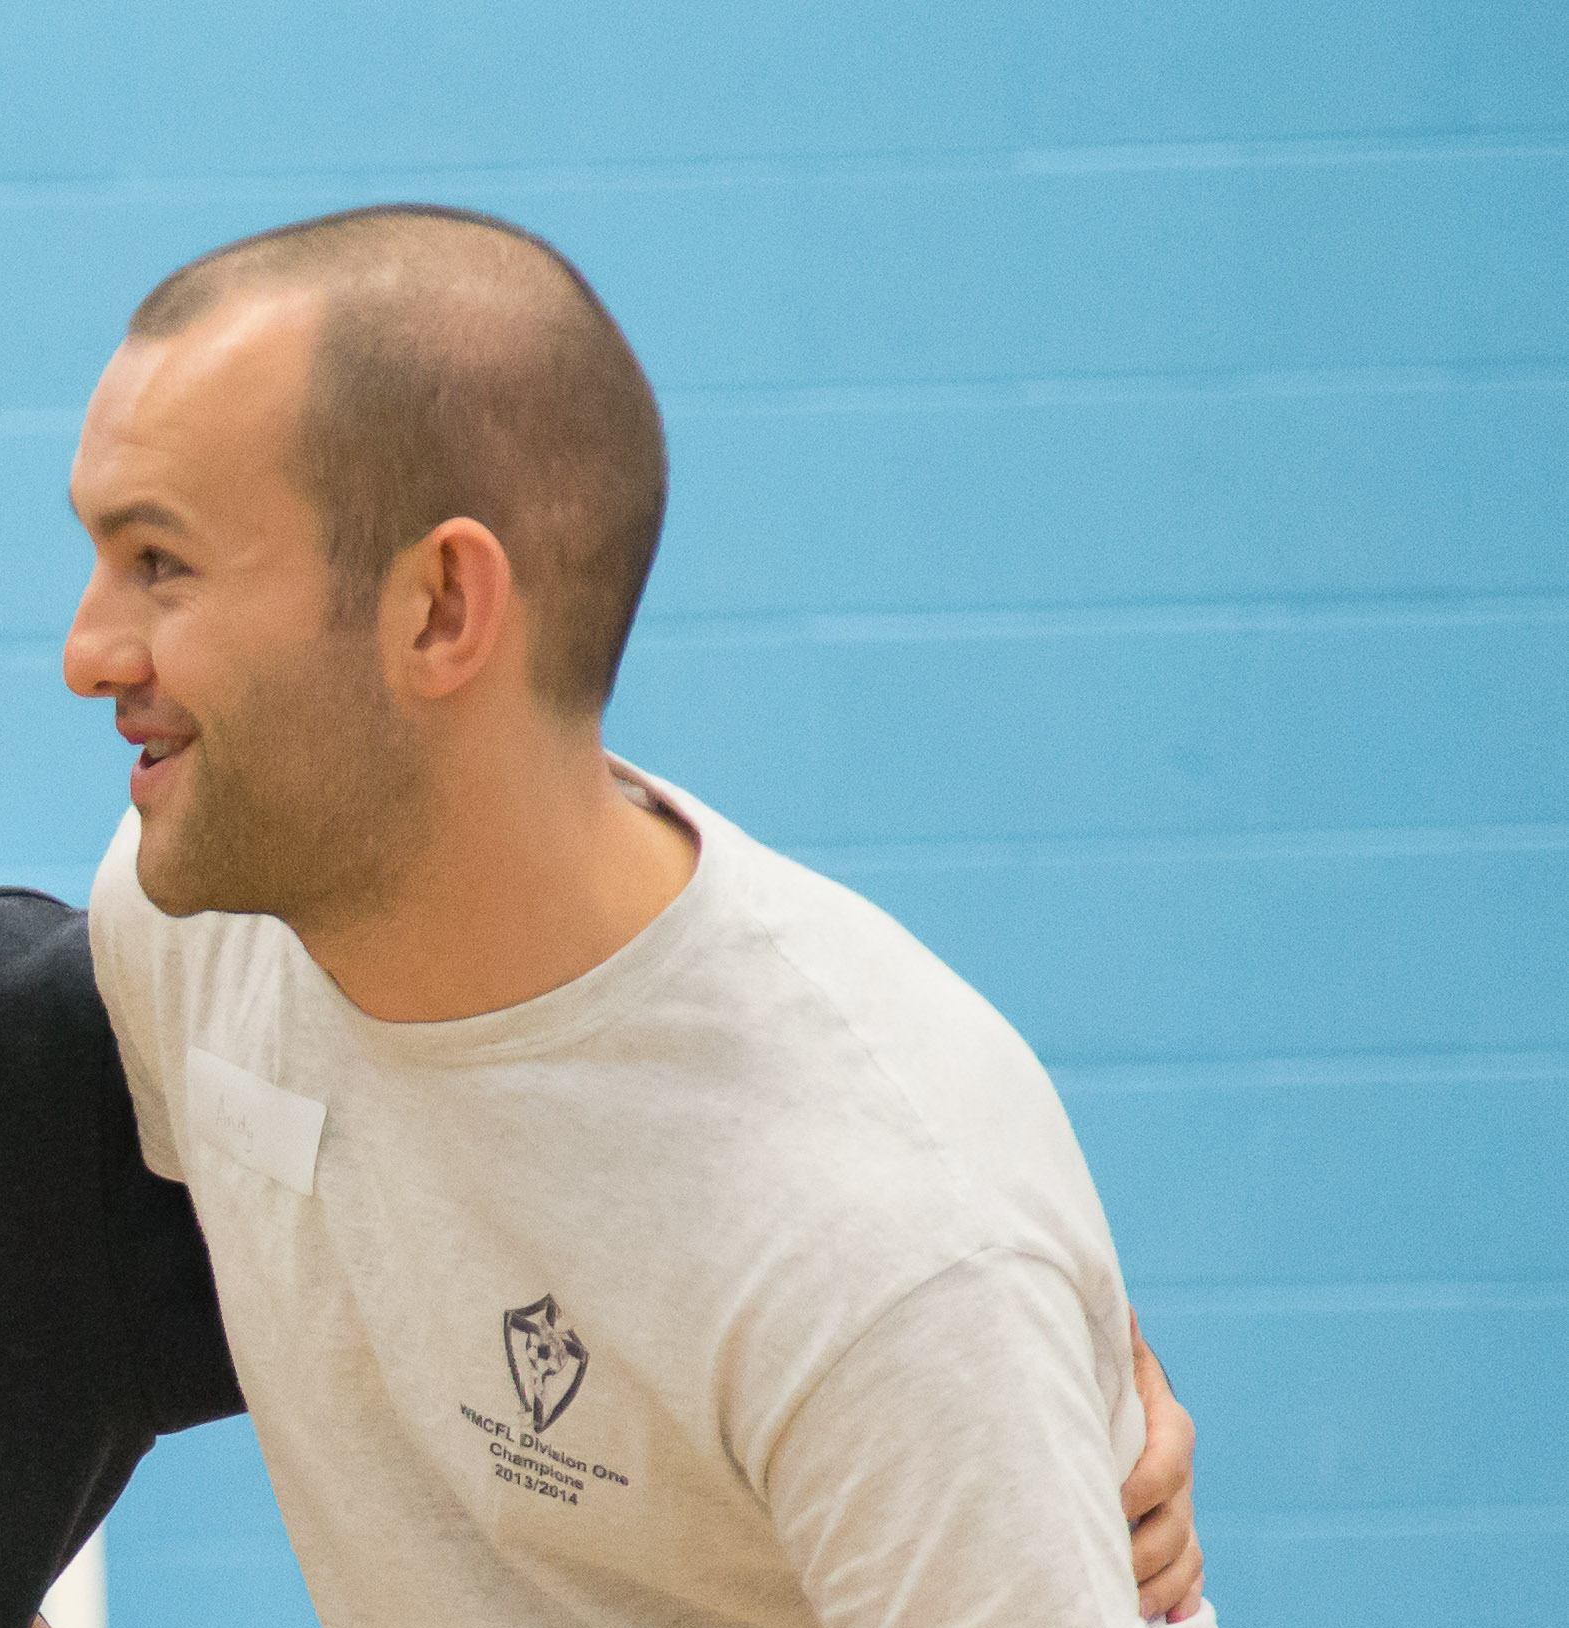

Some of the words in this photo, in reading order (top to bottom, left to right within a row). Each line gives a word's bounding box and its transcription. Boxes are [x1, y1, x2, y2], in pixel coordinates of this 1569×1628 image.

[459, 1401, 516, 1443] WMCFL
[519, 1432, 588, 1473] Division
[592, 1463, 630, 1487] One
[488, 1442, 585, 1491] Champions
[494, 1463, 579, 1506] 2013/2014
